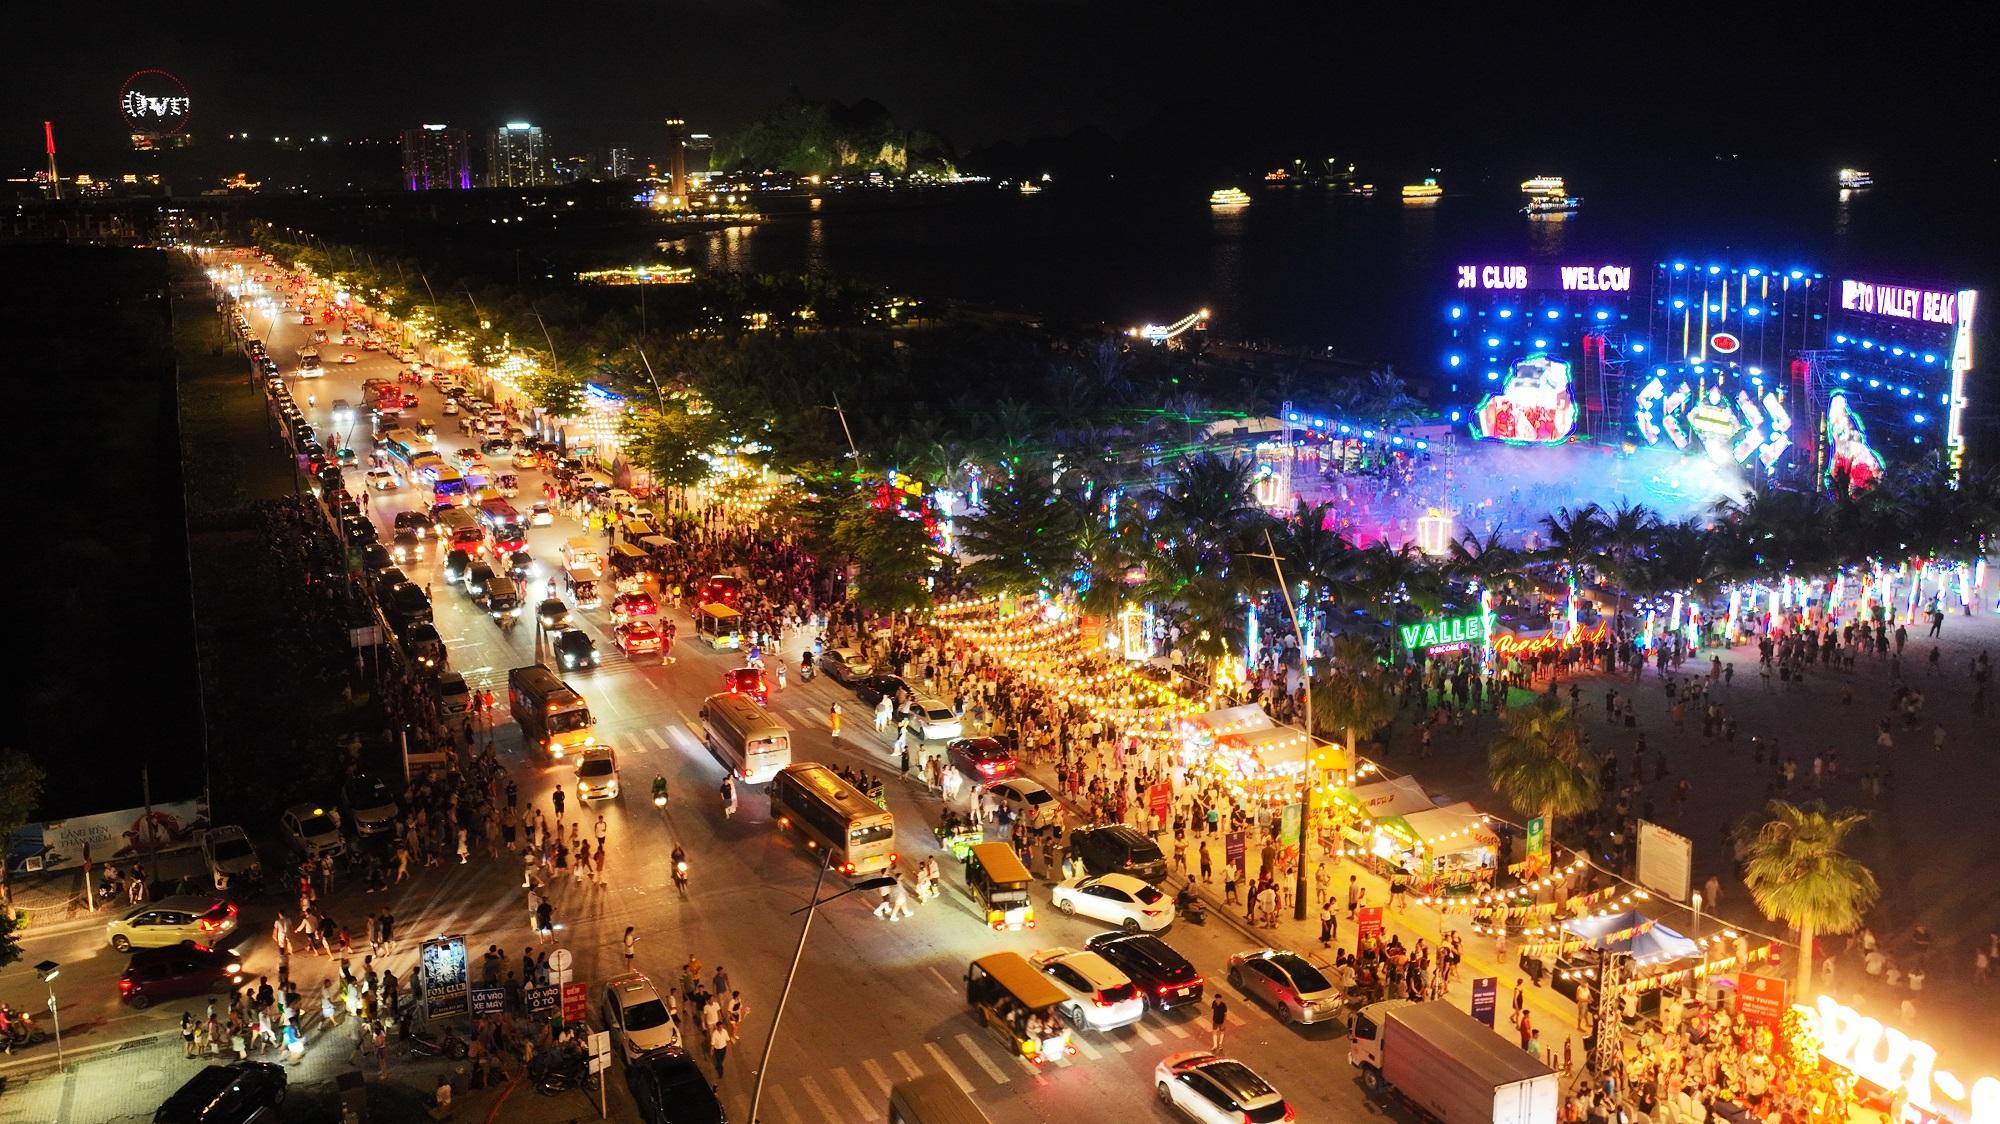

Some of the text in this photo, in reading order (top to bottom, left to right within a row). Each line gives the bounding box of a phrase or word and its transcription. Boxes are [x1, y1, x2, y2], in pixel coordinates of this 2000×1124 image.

[1482, 265, 1528, 290] CLUB
[1877, 286, 1921, 320] VALLEY
[1401, 614, 1496, 649] VALLEY
[473, 1002, 485, 1010] XE
